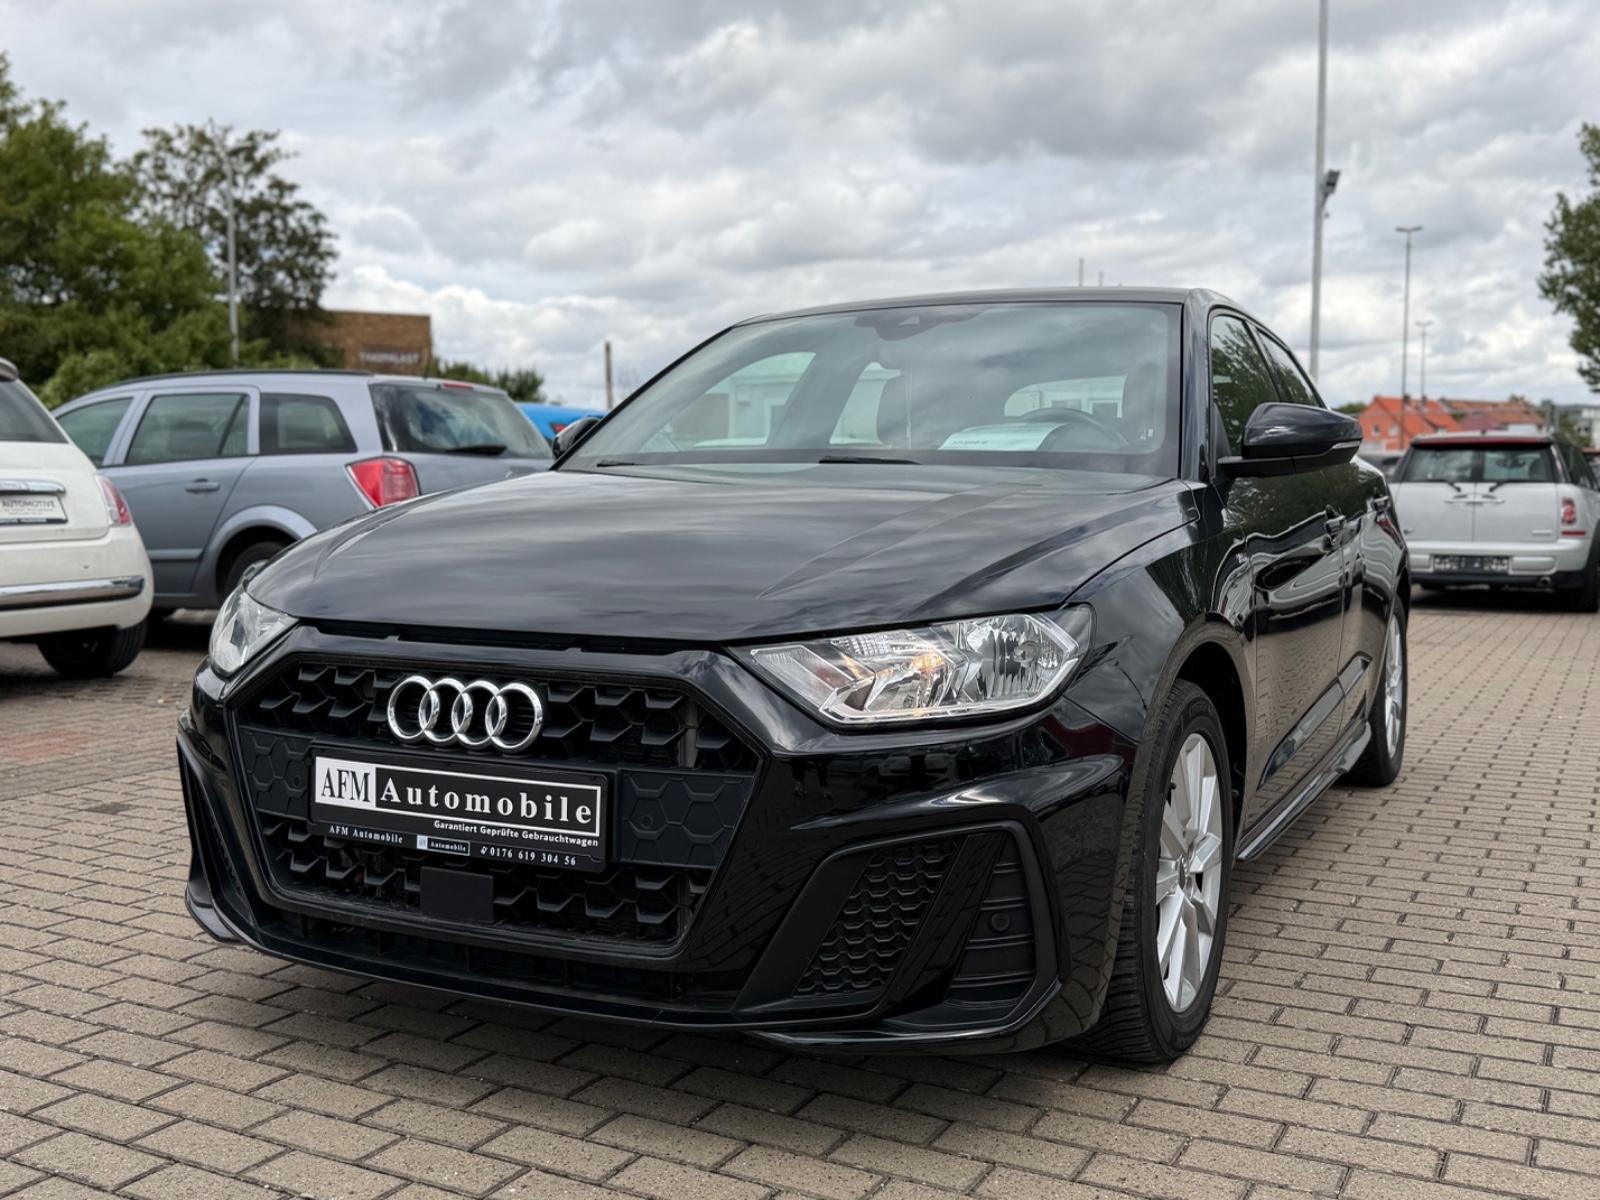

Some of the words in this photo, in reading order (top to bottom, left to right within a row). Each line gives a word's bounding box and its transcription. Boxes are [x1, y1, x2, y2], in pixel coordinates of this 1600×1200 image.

[321, 767, 371, 802] AFM
[380, 777, 592, 824] Automobile
[329, 825, 349, 836] AFM
[353, 829, 403, 844] Automobile
[434, 820, 478, 833] Garantiert
[480, 826, 519, 838] Geprüfte
[522, 831, 599, 847] Gebrauchtwagen
[430, 841, 466, 851] Automobile
[490, 847, 513, 858] 0176
[518, 851, 536, 862] 619
[541, 853, 559, 864] 304
[564, 857, 576, 866] 56
